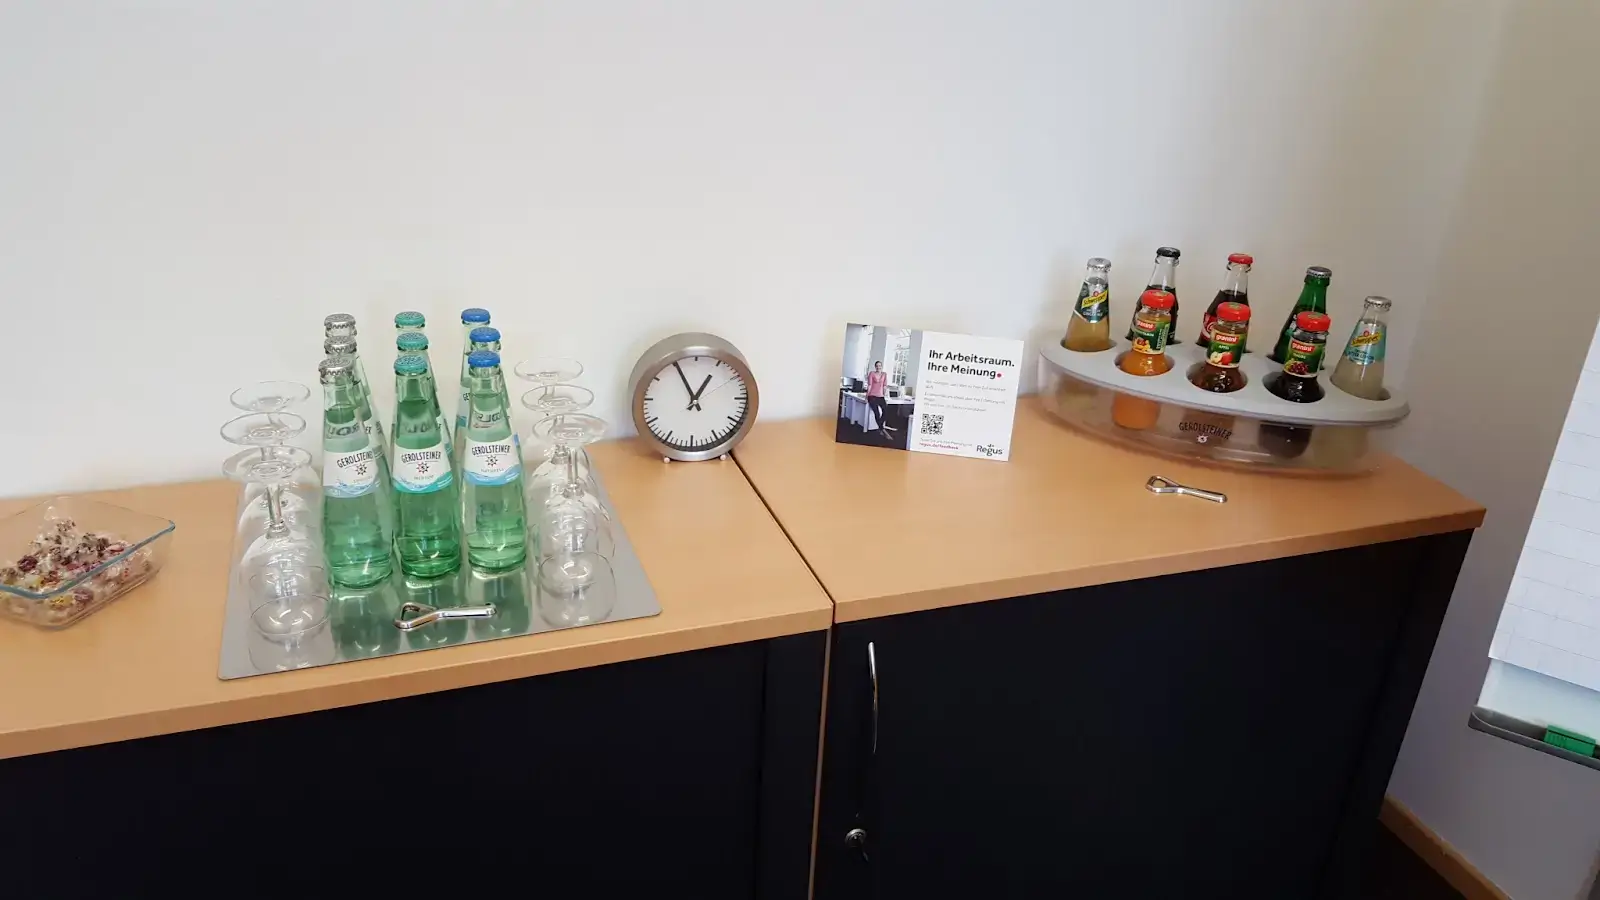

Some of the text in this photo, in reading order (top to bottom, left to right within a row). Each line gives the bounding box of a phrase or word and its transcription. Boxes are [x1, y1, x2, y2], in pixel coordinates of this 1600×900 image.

[1216, 334, 1237, 343] granini
[929, 350, 1015, 367] Ihr Arbeitsraum.
[927, 362, 948, 373] Ihre
[1178, 422, 1233, 440] GEROLSTEINER
[472, 444, 511, 456] GEROLSTEINER
[976, 444, 1003, 456] Regus
[401, 451, 441, 463] GEROLSTEINER
